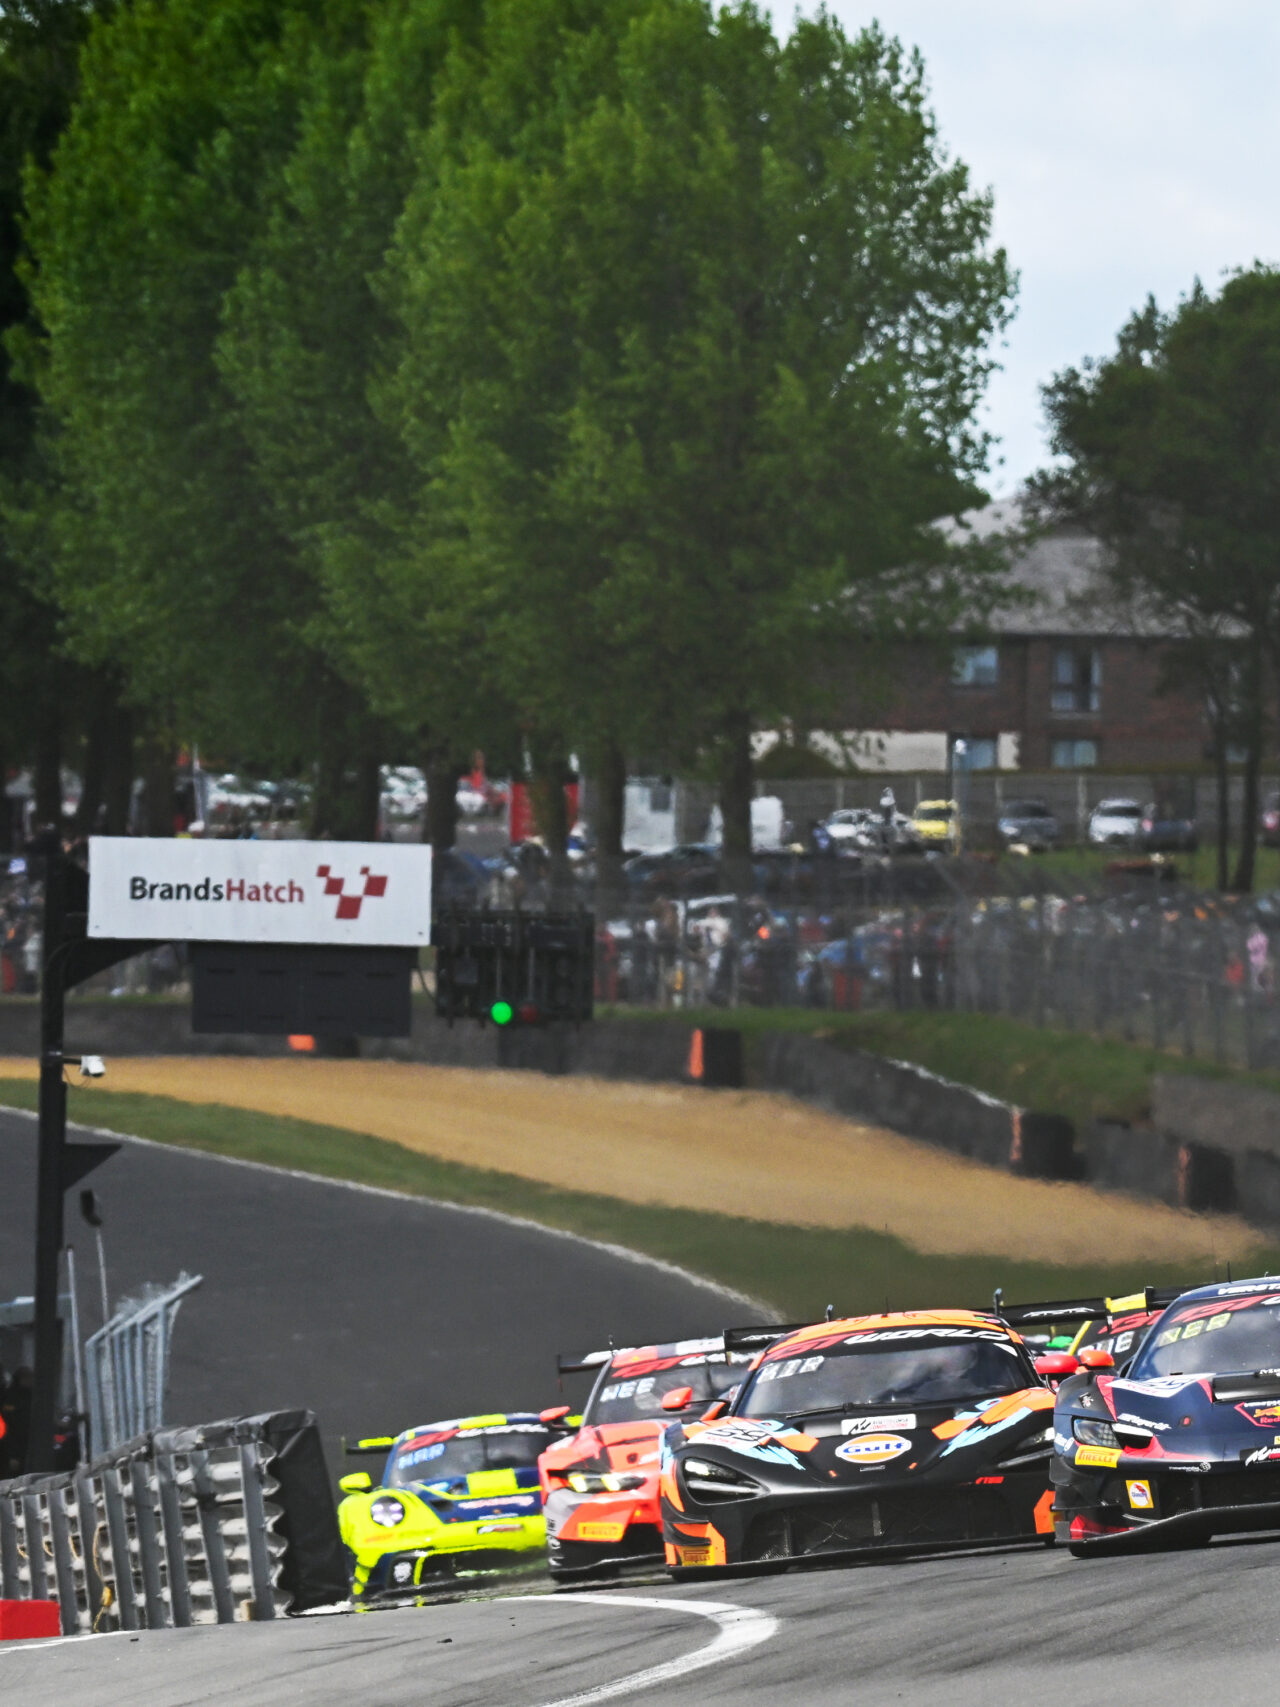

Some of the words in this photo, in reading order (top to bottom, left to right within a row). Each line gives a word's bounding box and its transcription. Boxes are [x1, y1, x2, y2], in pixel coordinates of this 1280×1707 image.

[129, 876, 304, 904] BrandsHatch
[843, 1442, 904, 1454] Gulf
[1078, 1449, 1115, 1464] PIRELLI
